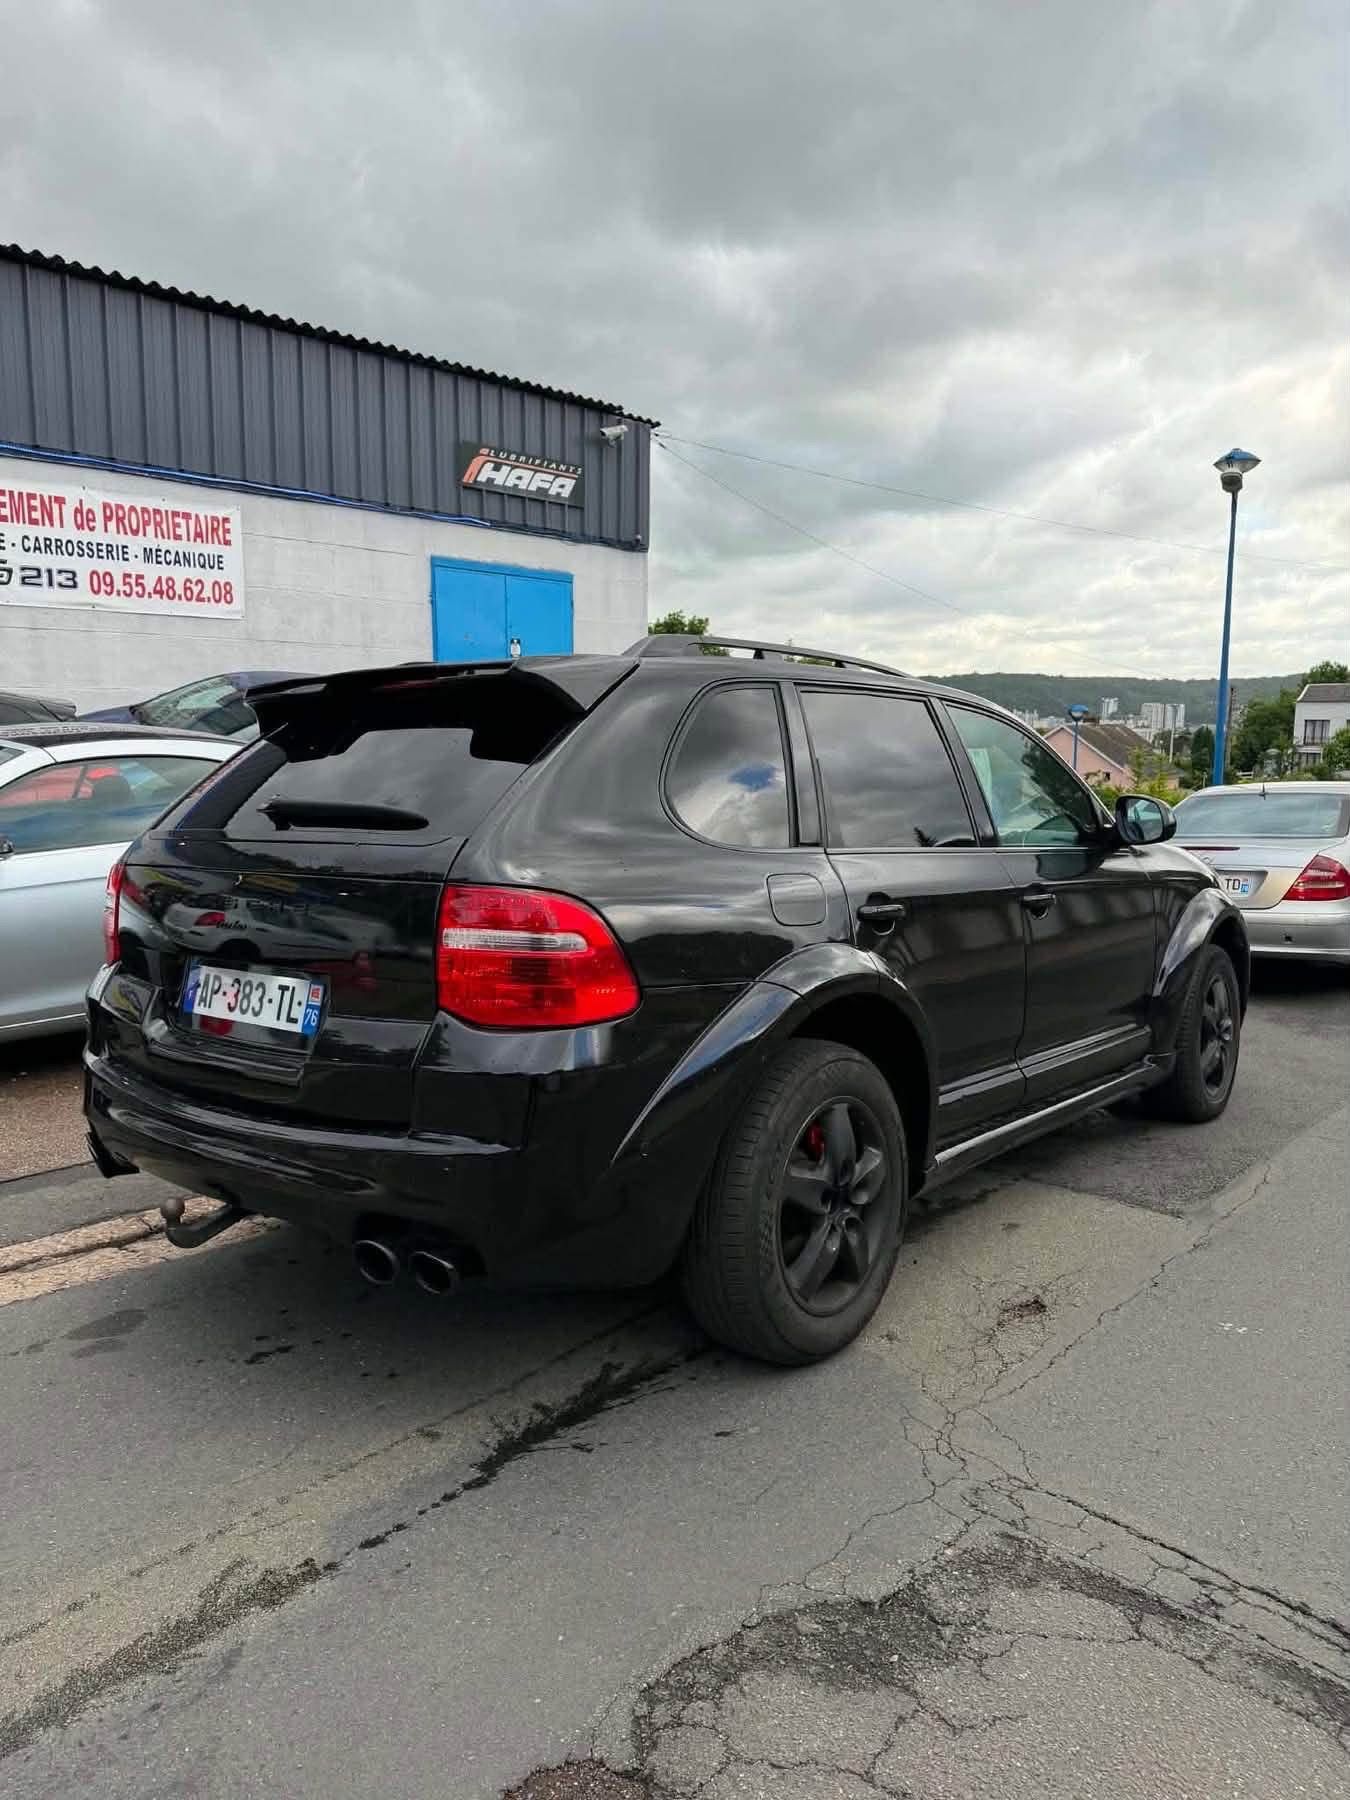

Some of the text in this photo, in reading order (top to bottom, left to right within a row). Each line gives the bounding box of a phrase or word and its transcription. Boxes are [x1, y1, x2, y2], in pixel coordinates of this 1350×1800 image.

[476, 462, 577, 498] HAFA
[73, 499, 96, 532] de
[102, 501, 233, 546] PROPRIETAIRE
[21, 535, 130, 561] CARROSSERIE
[143, 545, 225, 570] MÉCANIQUE
[89, 570, 234, 605] 09.55.48.62.08
[304, 1008, 319, 1027] 76
